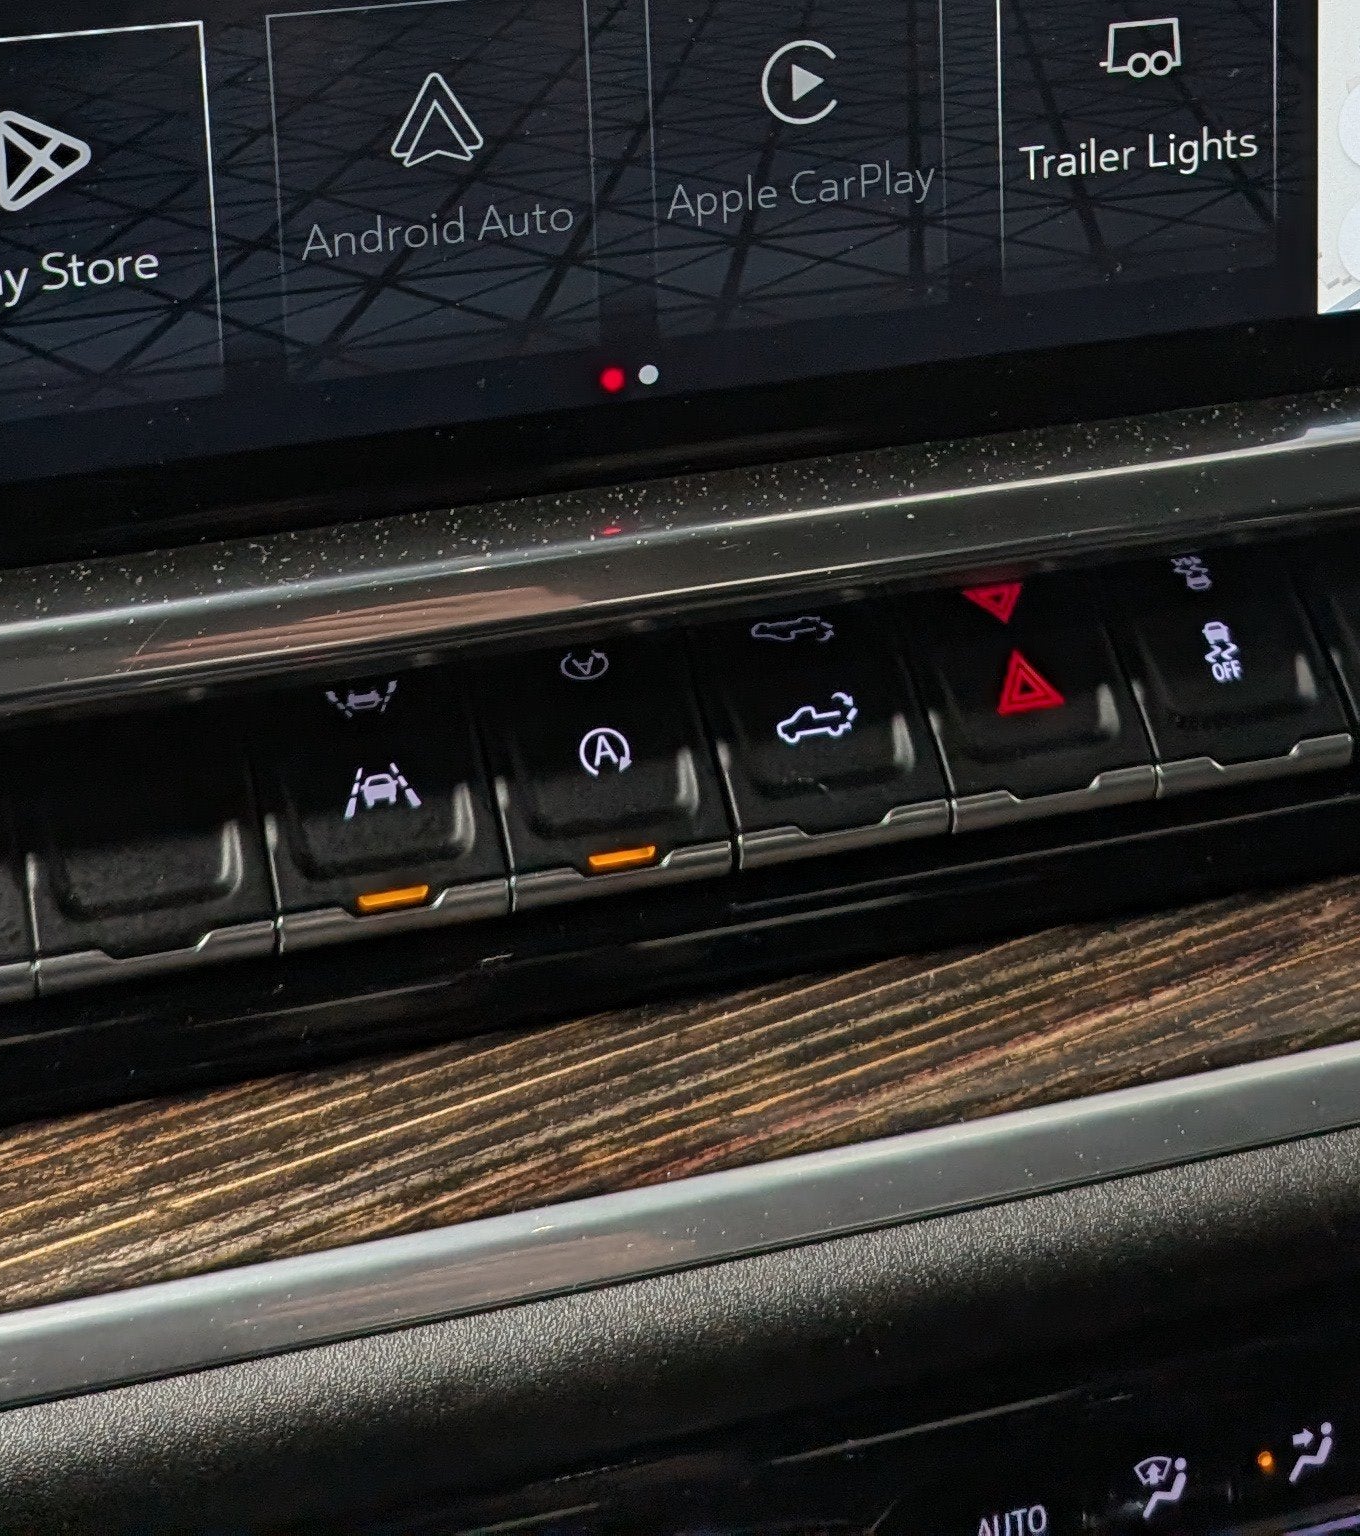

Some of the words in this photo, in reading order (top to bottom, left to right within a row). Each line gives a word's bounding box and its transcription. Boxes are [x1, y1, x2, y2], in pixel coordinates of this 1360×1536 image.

[1018, 137, 1137, 182] Trailer
[1147, 125, 1259, 176] Lights
[666, 172, 779, 228] Apple
[789, 159, 937, 206] CarPlay
[300, 205, 466, 261] Android
[476, 202, 575, 242] Auto
[41, 250, 160, 292] Store
[1211, 659, 1242, 683] OFF
[977, 1504, 1047, 1536] AUTO
